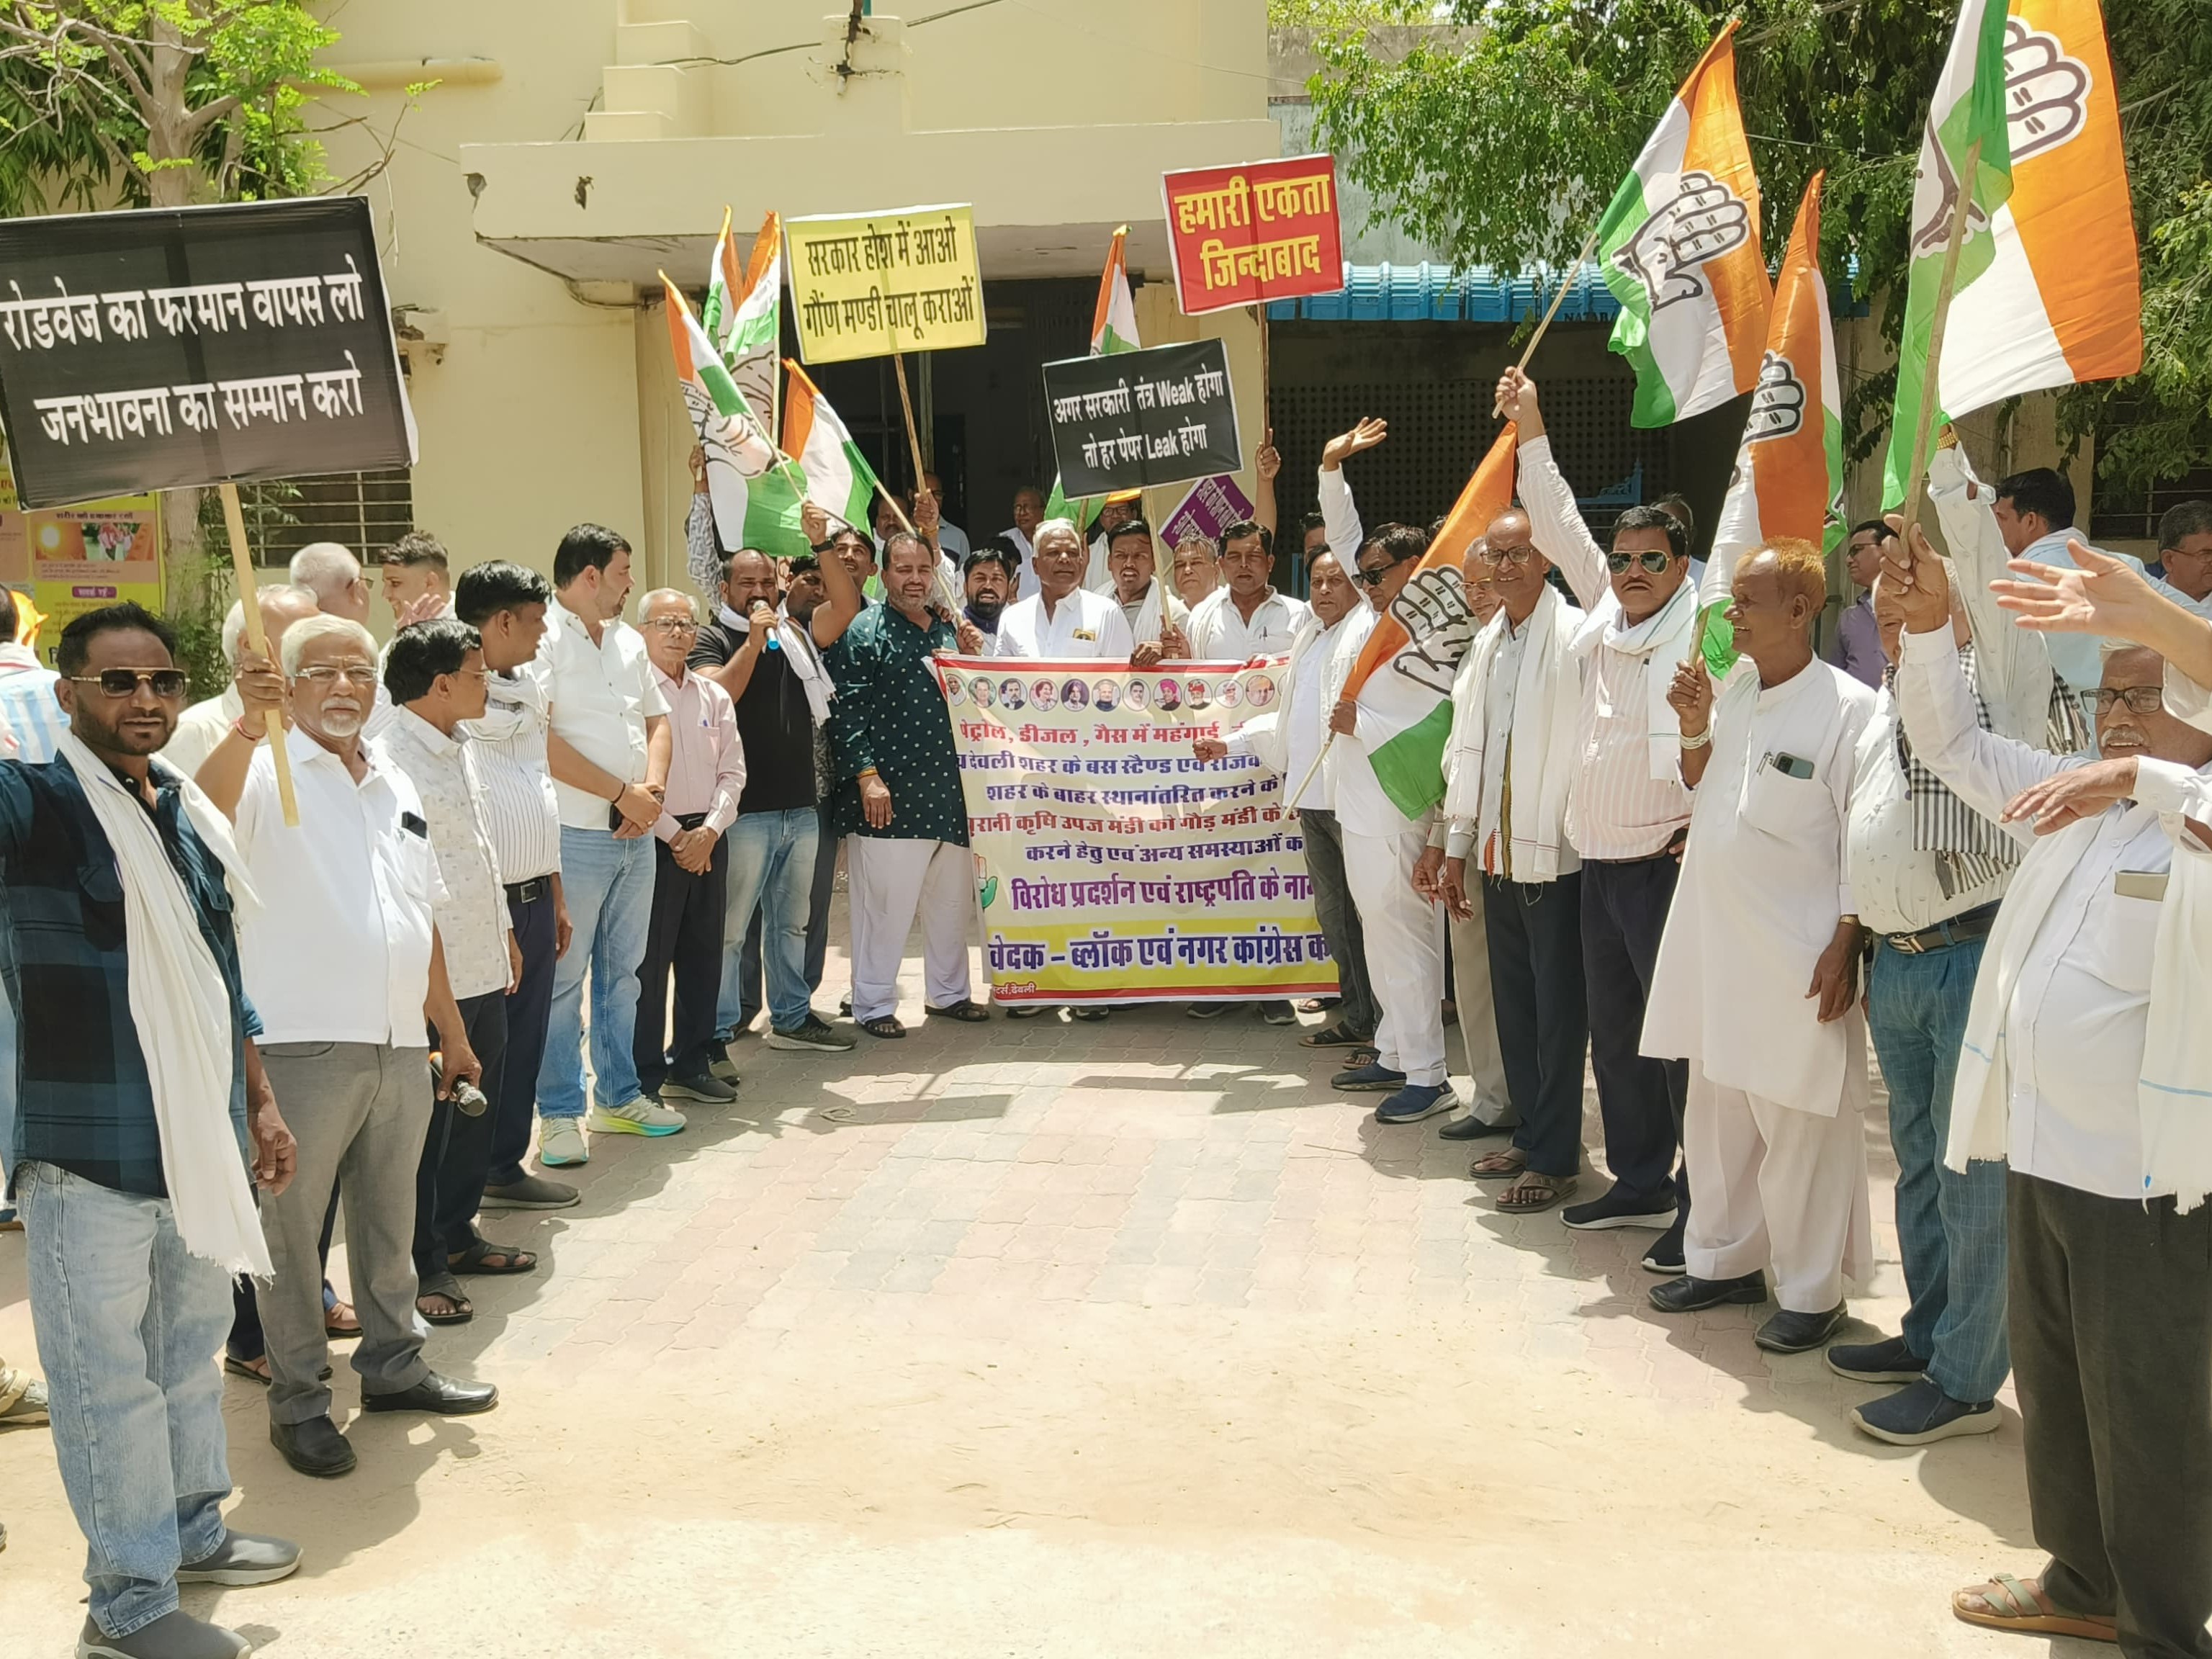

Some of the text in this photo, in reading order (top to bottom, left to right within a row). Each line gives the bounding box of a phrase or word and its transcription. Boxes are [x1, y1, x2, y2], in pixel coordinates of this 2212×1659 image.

[1174, 174, 1330, 233] हमारी एकता
[805, 216, 958, 276] सरकार होश में आओ
[1200, 235, 1321, 289] जिन्दाबाद
[0, 253, 365, 350] रोडवेज का फरमान वापस लो
[842, 286, 884, 333] मण्डी
[884, 292, 924, 340] चालू
[35, 349, 365, 445] जनभावना का सम्मान करो
[1053, 363, 1224, 423] अगर सरकारी तंत्र Weak होगा
[1082, 416, 1208, 469] तो हर पेपर Leak होगा
[1094, 724, 1128, 744] गैस
[1132, 723, 1151, 743] में
[969, 750, 1015, 769] देवली
[1019, 756, 1058, 773] शहर
[1061, 755, 1081, 775] के
[1086, 759, 1118, 774] बस
[1121, 754, 1172, 774] स्टैण्ड
[986, 784, 1028, 801] शहर
[1031, 781, 1049, 799] के
[1052, 788, 1097, 804] बाहर
[1102, 784, 1205, 805] स्थानांतरित
[1208, 779, 1256, 800] करने
[1259, 775, 1280, 793] के
[1015, 810, 1057, 835] कृषि
[1060, 816, 1104, 833] उपज
[1107, 816, 1145, 834] मंडी
[1148, 814, 1176, 832] को
[1180, 812, 1216, 832] गौड़
[1221, 806, 1258, 826] मंडी
[1262, 802, 1282, 822] के
[1025, 840, 1071, 861] करने
[1075, 840, 1103, 864] हेतु
[1106, 844, 1139, 862] एवं
[1140, 846, 1183, 862] अन्य
[1187, 832, 1282, 859] समस्याओं
[1012, 876, 1067, 909] विरोध
[1070, 873, 1136, 907] प्रदर्शन
[1139, 875, 1171, 904] एवं
[1174, 869, 1256, 907] राष्ट्रपति
[1259, 867, 1279, 900] के
[1070, 931, 1133, 968] ब्लॉक
[1137, 928, 1174, 966] एवं
[1177, 937, 1228, 964] नगर
[1232, 926, 1303, 965] कांग्रेस
